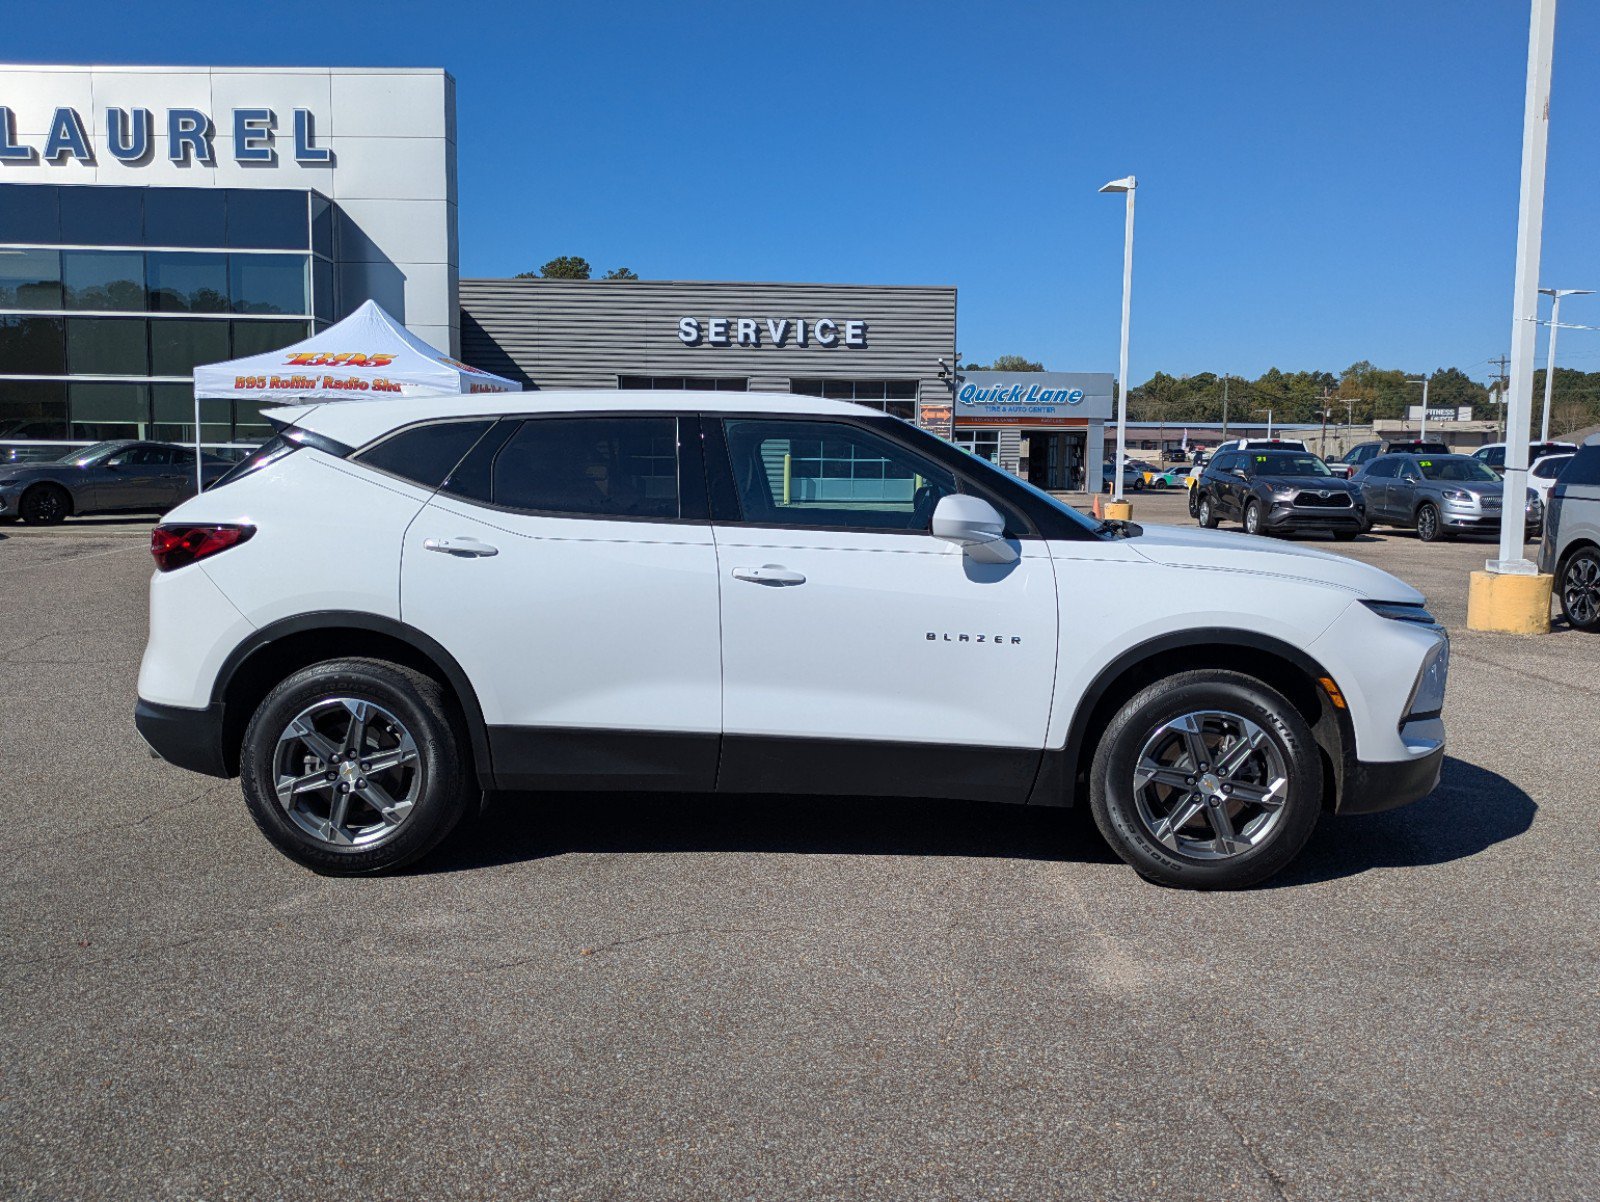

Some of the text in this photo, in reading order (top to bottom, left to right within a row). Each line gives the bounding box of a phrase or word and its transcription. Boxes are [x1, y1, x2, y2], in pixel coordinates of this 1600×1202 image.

[0, 106, 332, 163] LAUREL
[678, 317, 865, 345] SERVICE
[234, 376, 404, 392] B95 Rollin' Radio Sho
[959, 383, 1084, 404] Quick Lane
[925, 632, 1021, 644] BLAZER
